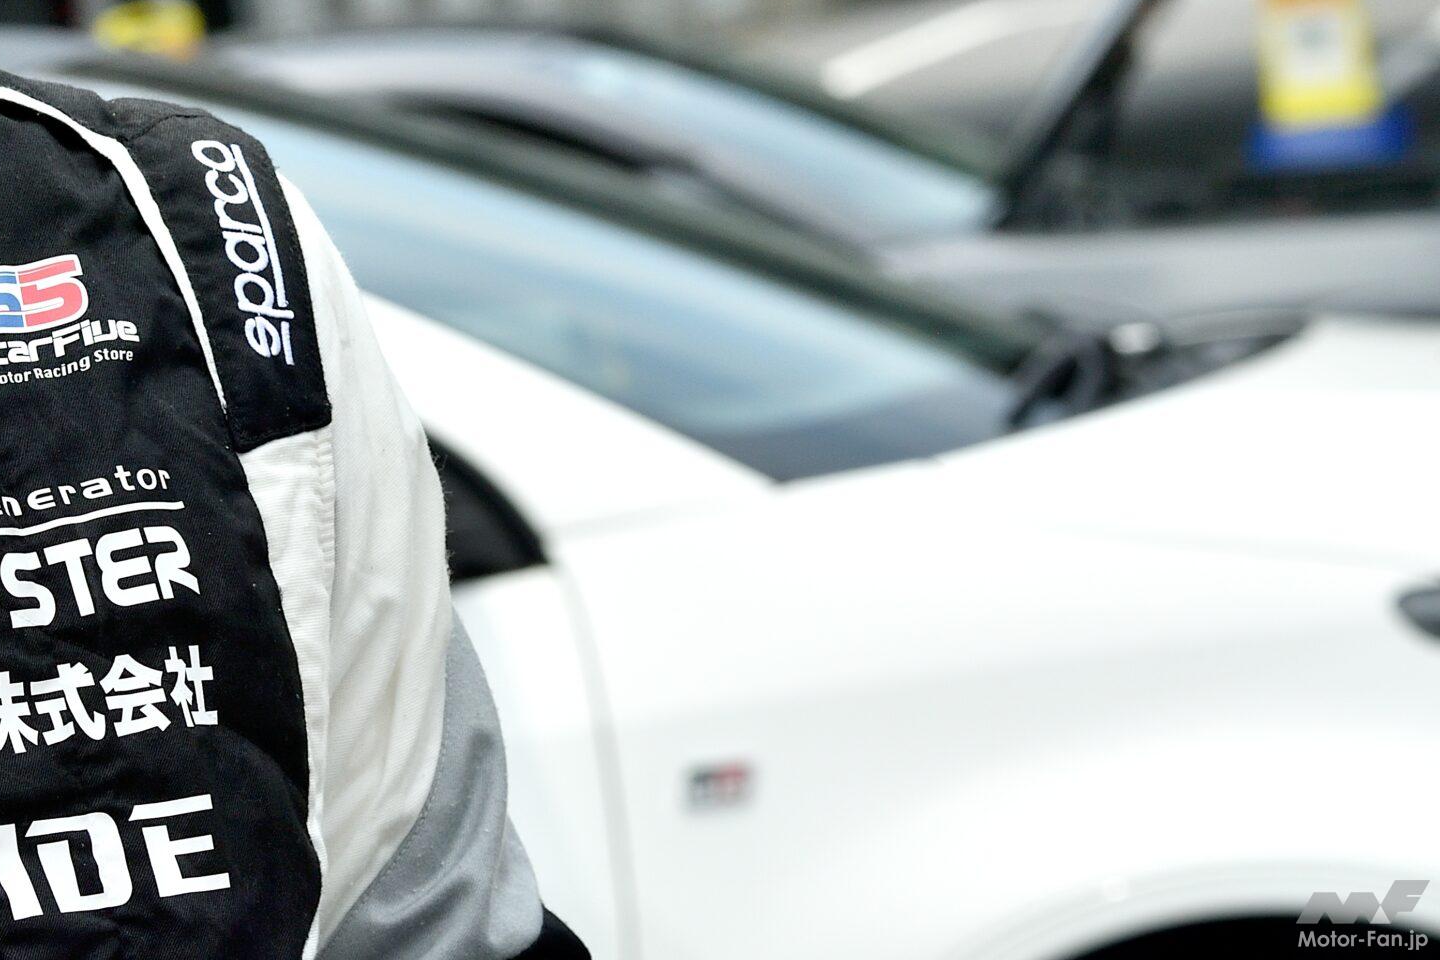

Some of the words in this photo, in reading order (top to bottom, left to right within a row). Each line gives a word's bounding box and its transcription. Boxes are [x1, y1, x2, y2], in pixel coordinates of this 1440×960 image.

[191, 139, 296, 366] sparco
[33, 355, 92, 380] Racing
[93, 348, 134, 363] Store
